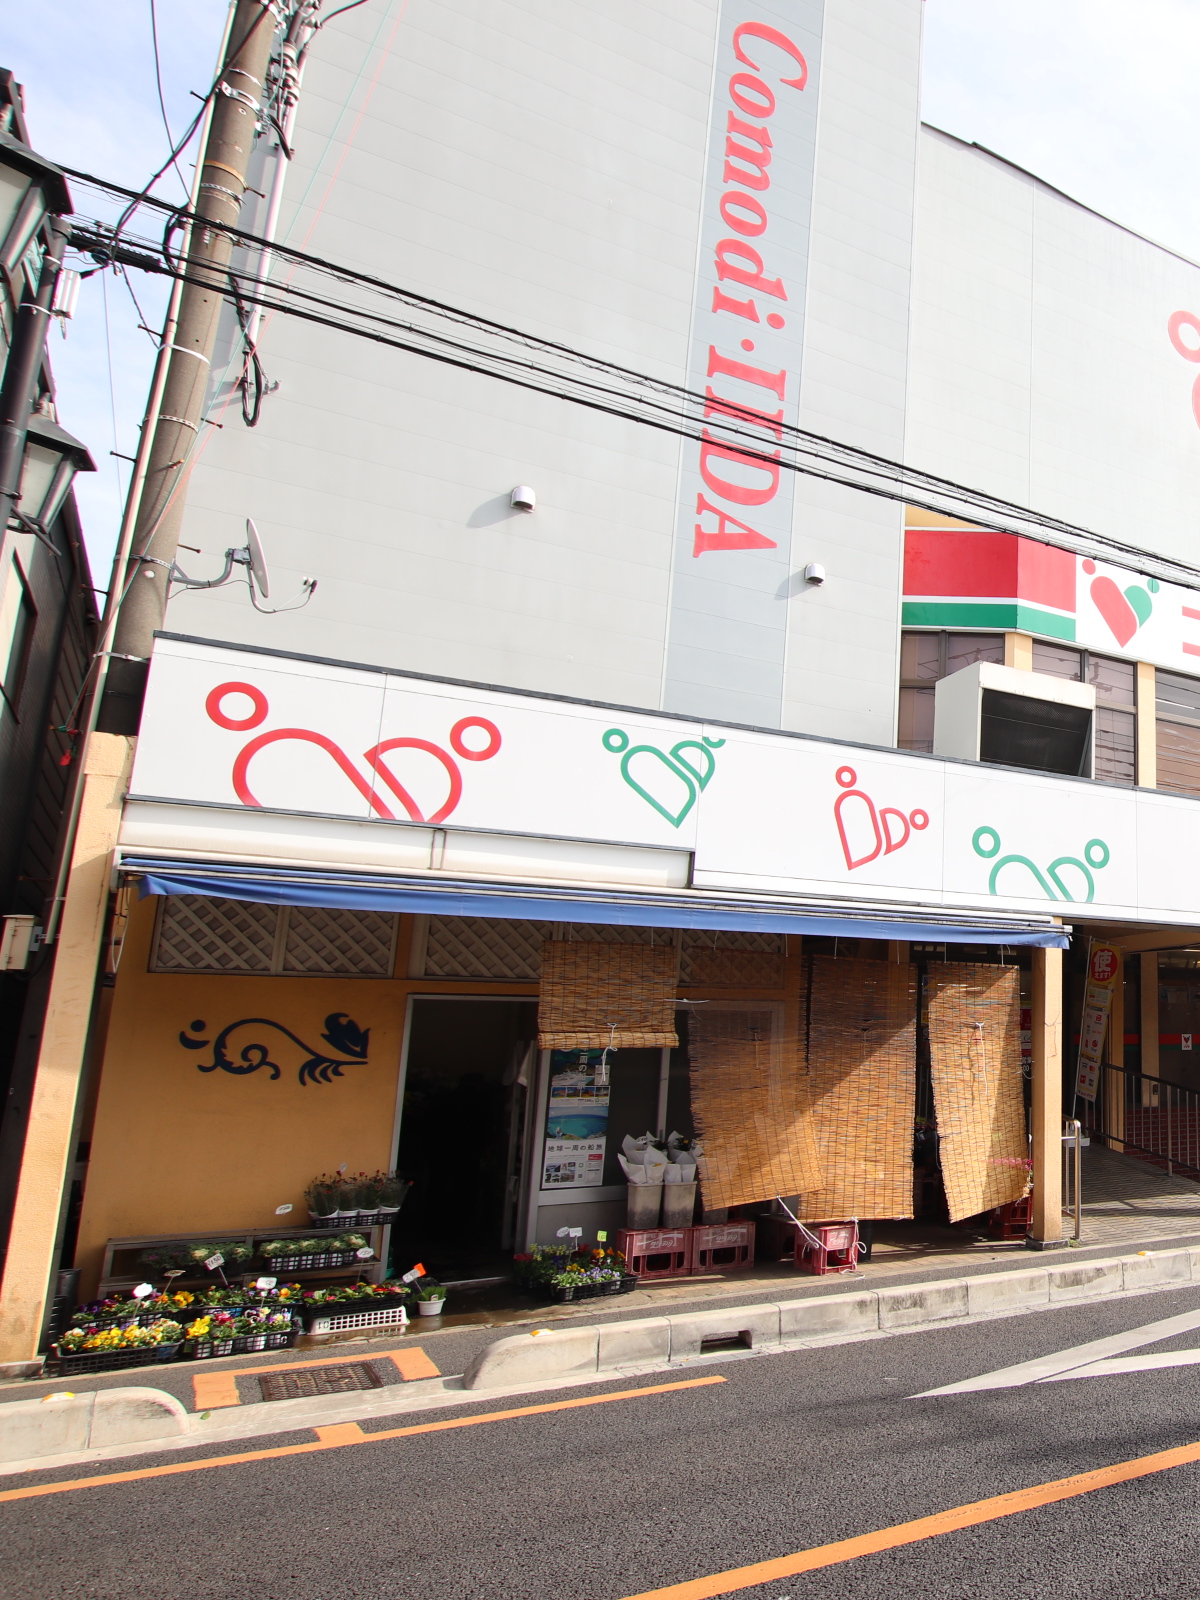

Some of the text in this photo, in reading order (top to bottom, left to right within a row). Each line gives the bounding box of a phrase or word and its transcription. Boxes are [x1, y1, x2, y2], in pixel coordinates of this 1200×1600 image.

[1094, 951, 1112, 972] 使
[547, 1143, 603, 1153] 地球一周の船旅
